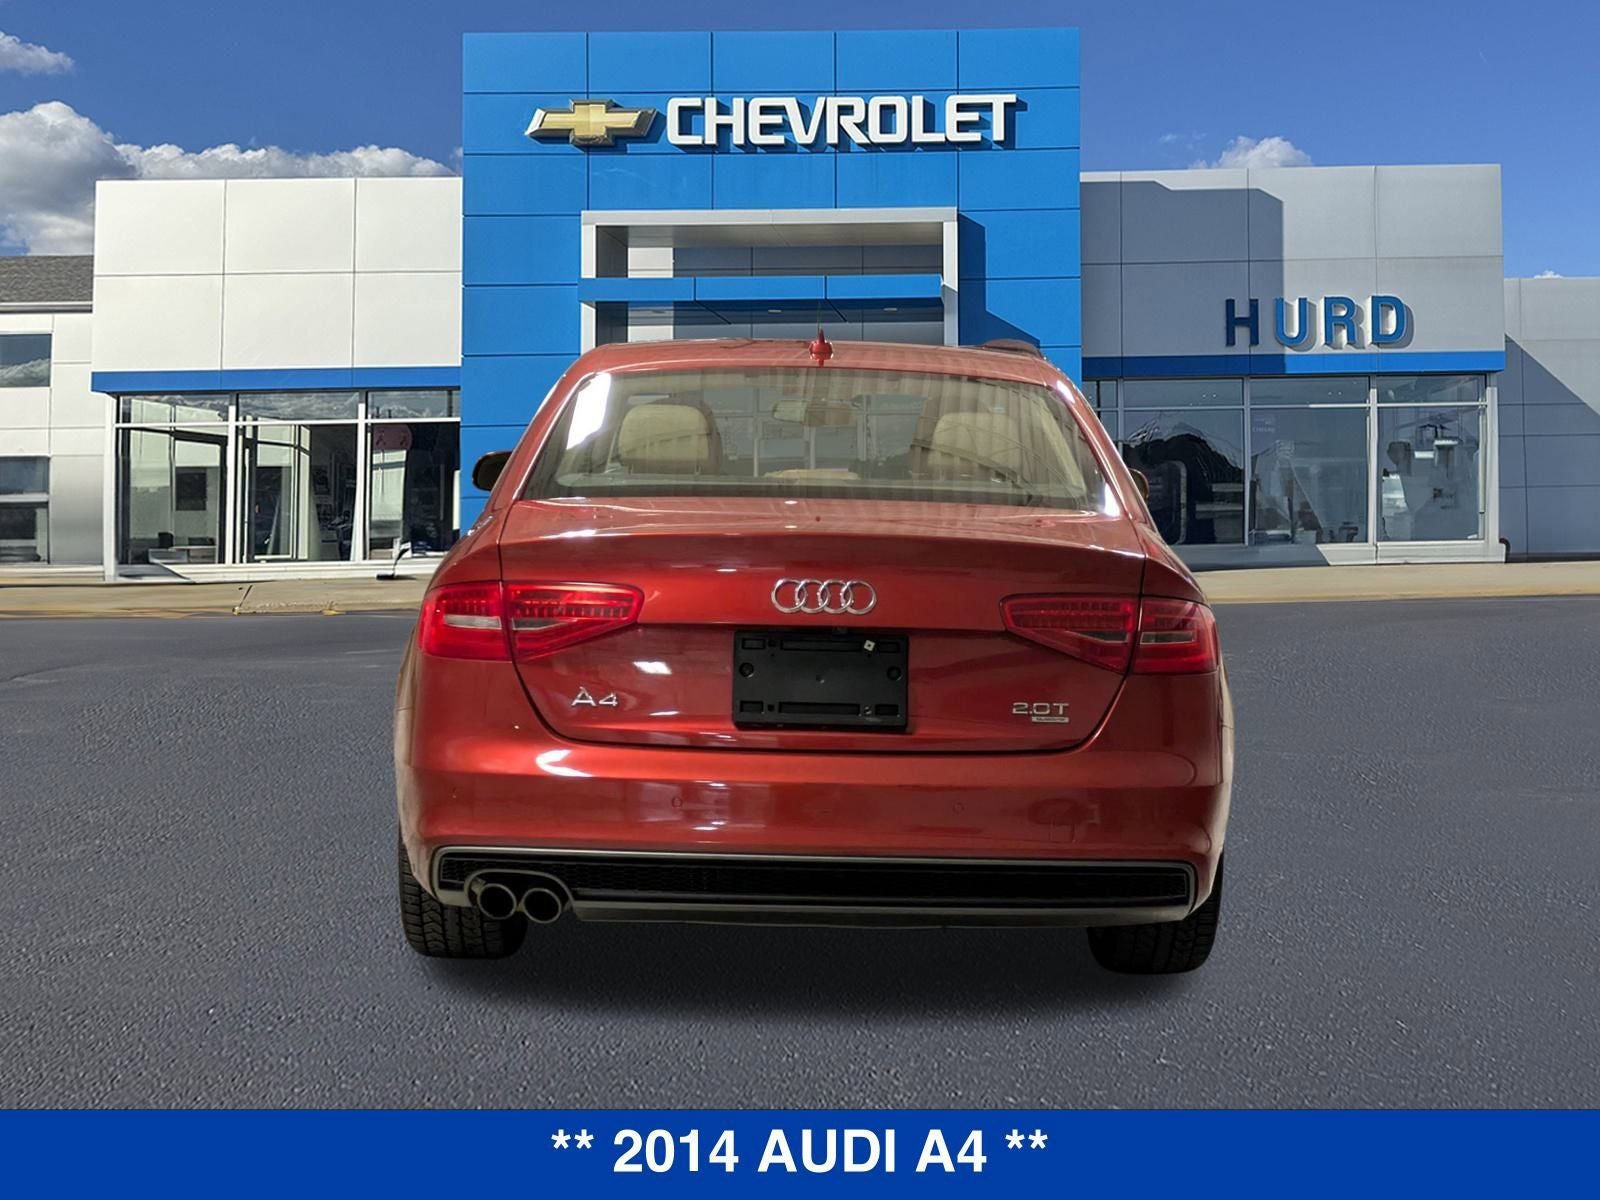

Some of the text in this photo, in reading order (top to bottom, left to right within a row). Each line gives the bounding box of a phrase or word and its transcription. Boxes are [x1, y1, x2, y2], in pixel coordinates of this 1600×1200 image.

[666, 94, 1017, 145] CHEVROLET
[1224, 295, 1408, 347] HURD
[571, 686, 618, 707] A4
[1012, 702, 1069, 715] 2.0T
